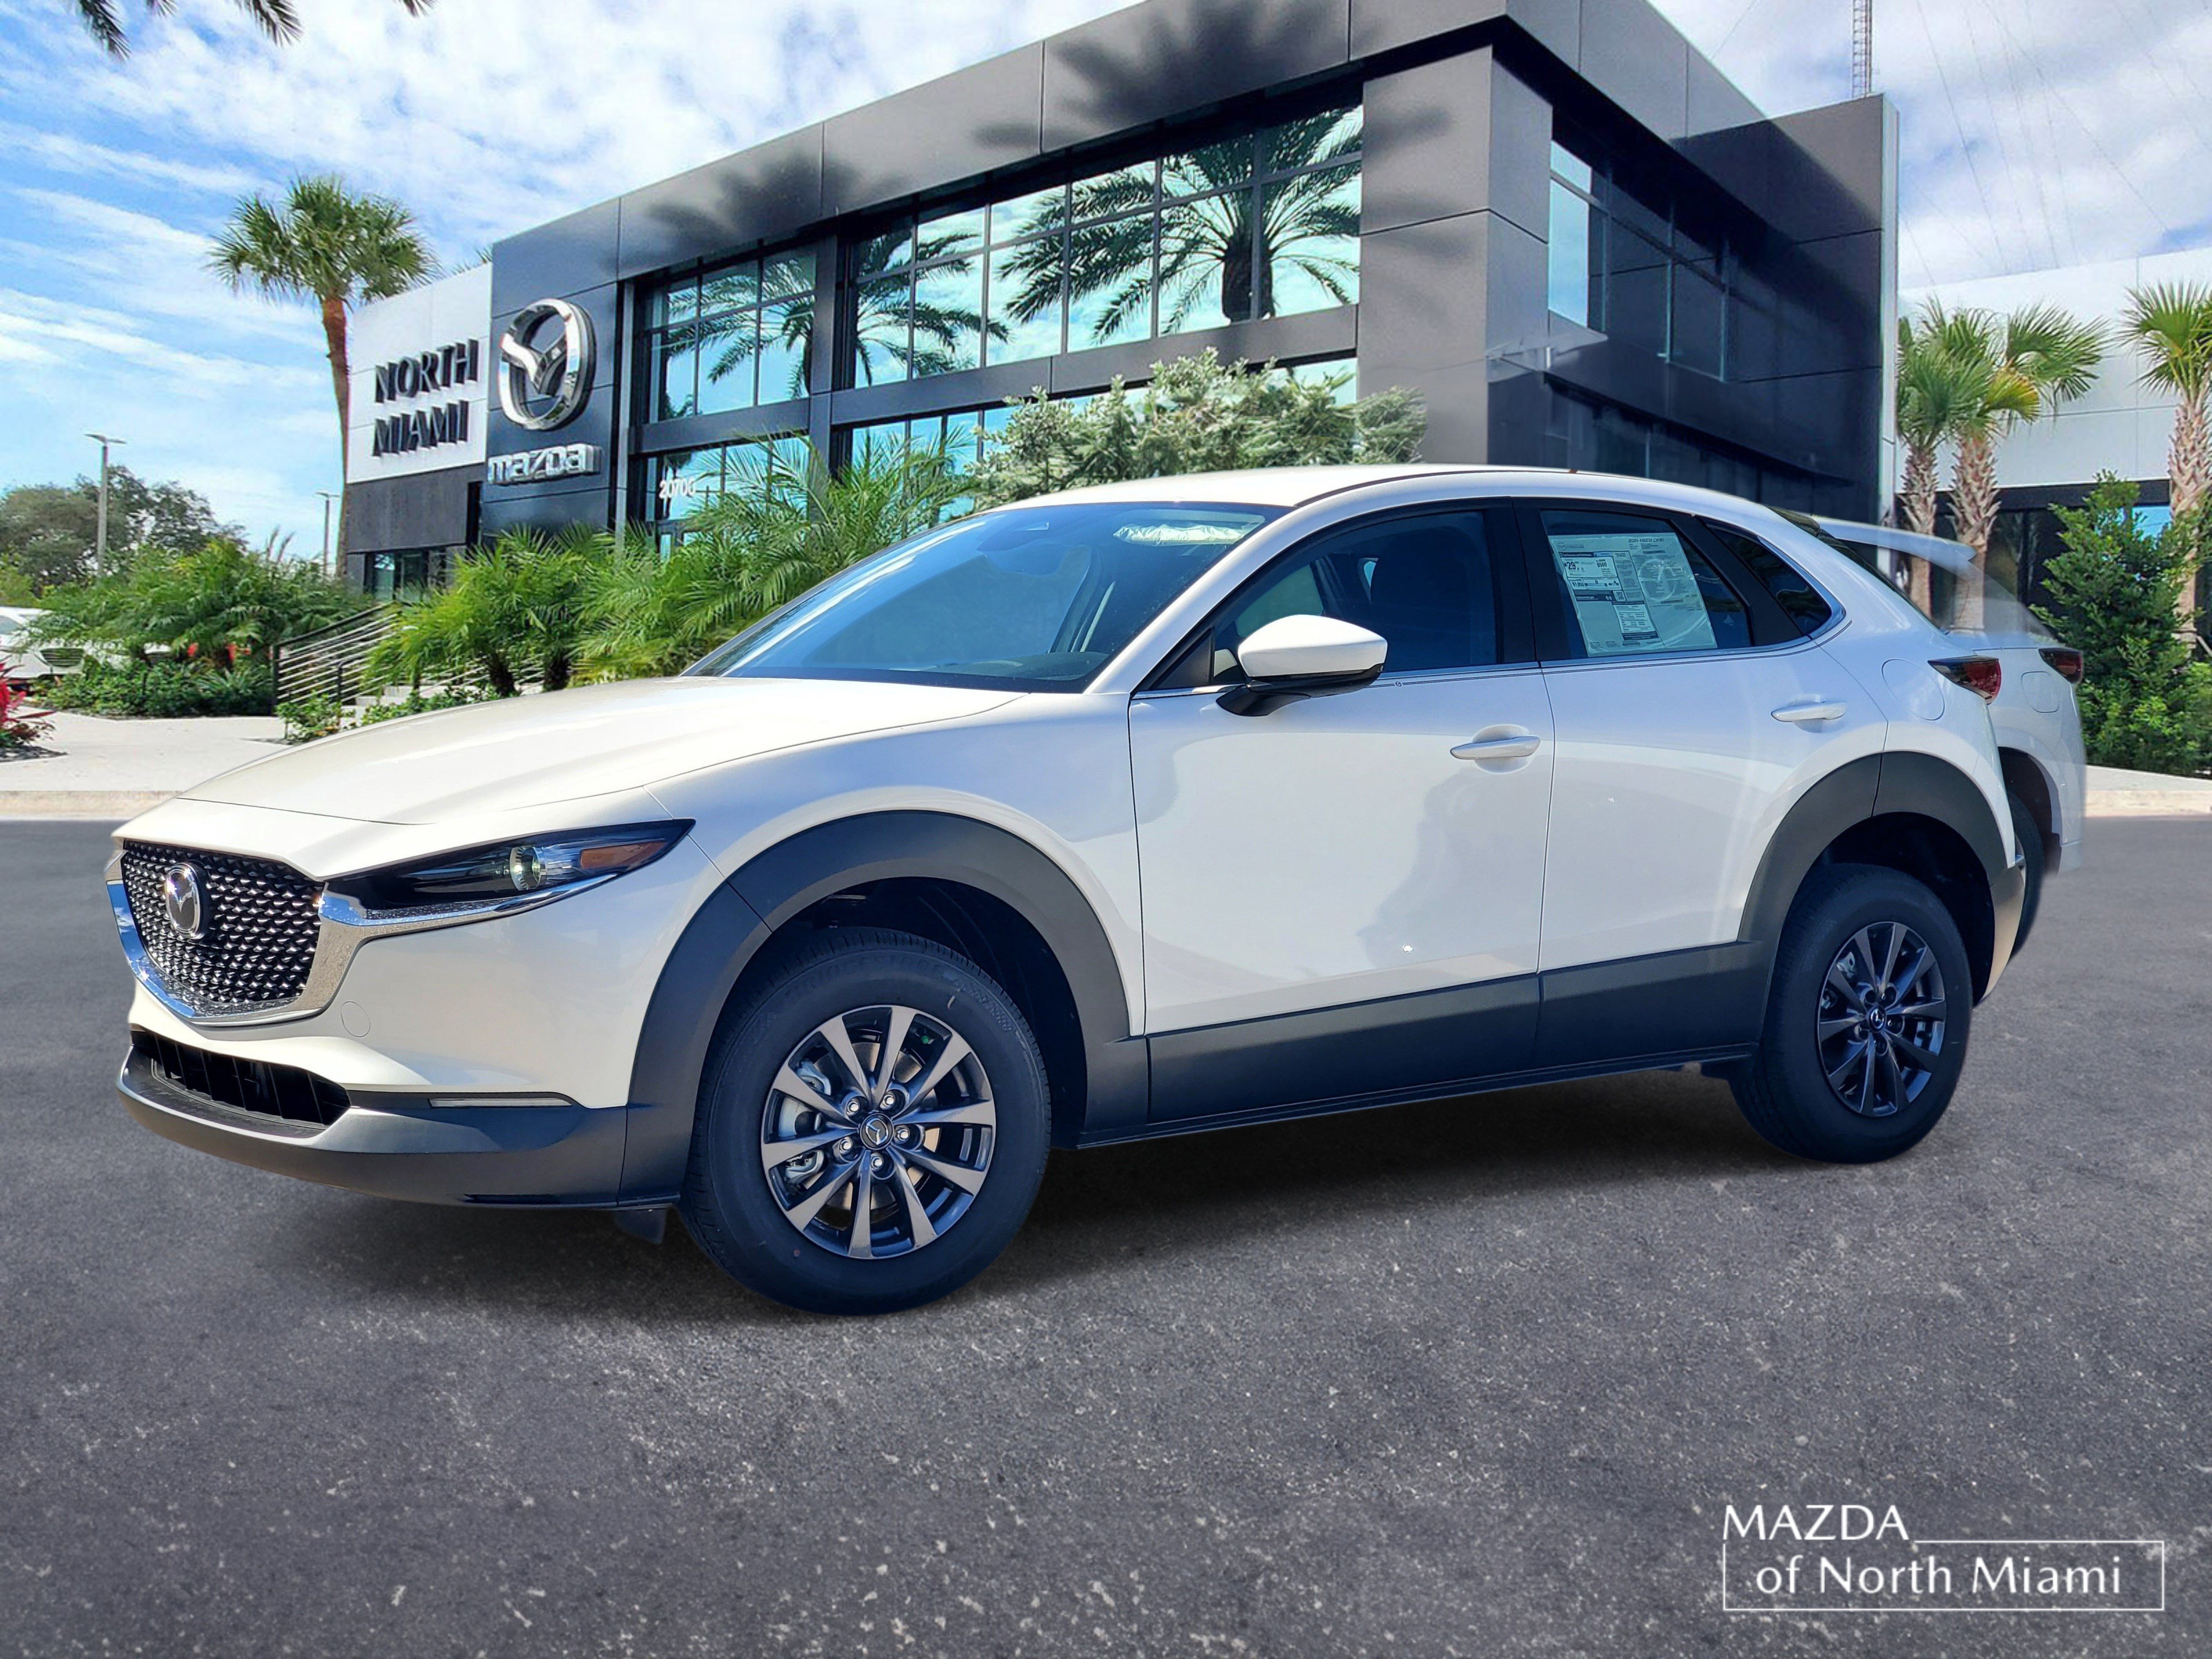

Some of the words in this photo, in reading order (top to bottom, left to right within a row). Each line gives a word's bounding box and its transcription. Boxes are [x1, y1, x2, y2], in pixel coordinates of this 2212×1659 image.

[375, 339, 479, 404] NORTH
[372, 400, 469, 457] MIAMI
[487, 443, 602, 487] mazda
[1567, 562, 1576, 570] 29
